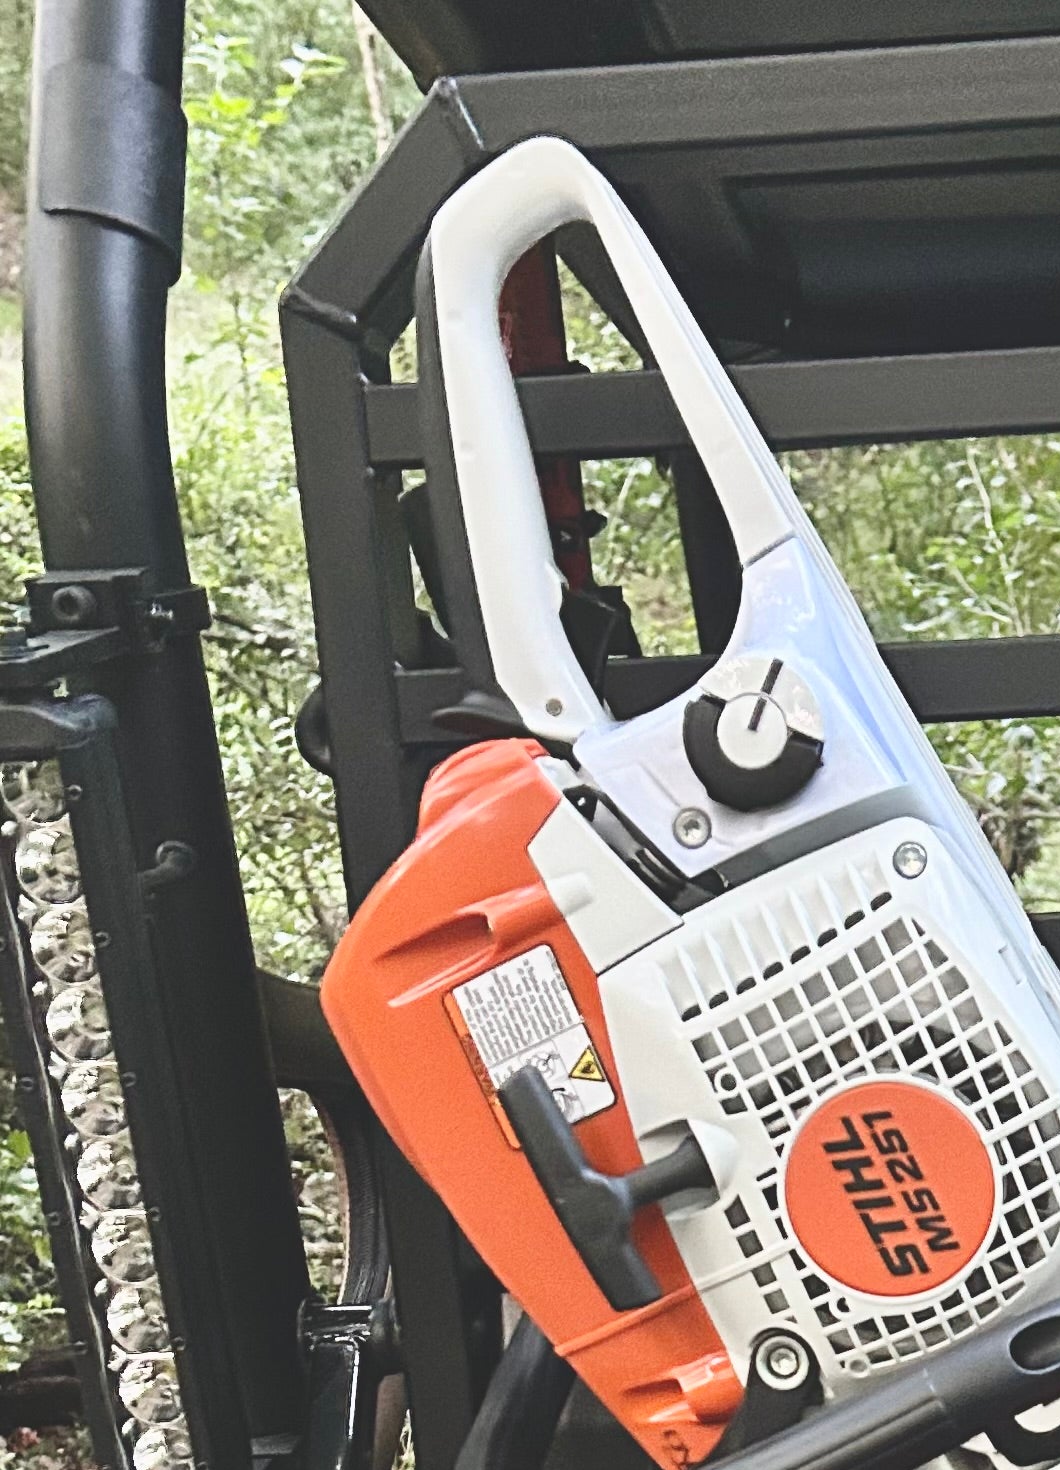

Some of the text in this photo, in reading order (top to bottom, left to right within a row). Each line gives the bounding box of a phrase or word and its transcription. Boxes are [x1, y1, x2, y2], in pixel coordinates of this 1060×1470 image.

[823, 1116, 929, 1276] STIHL
[861, 1111, 961, 1252] MS 251
